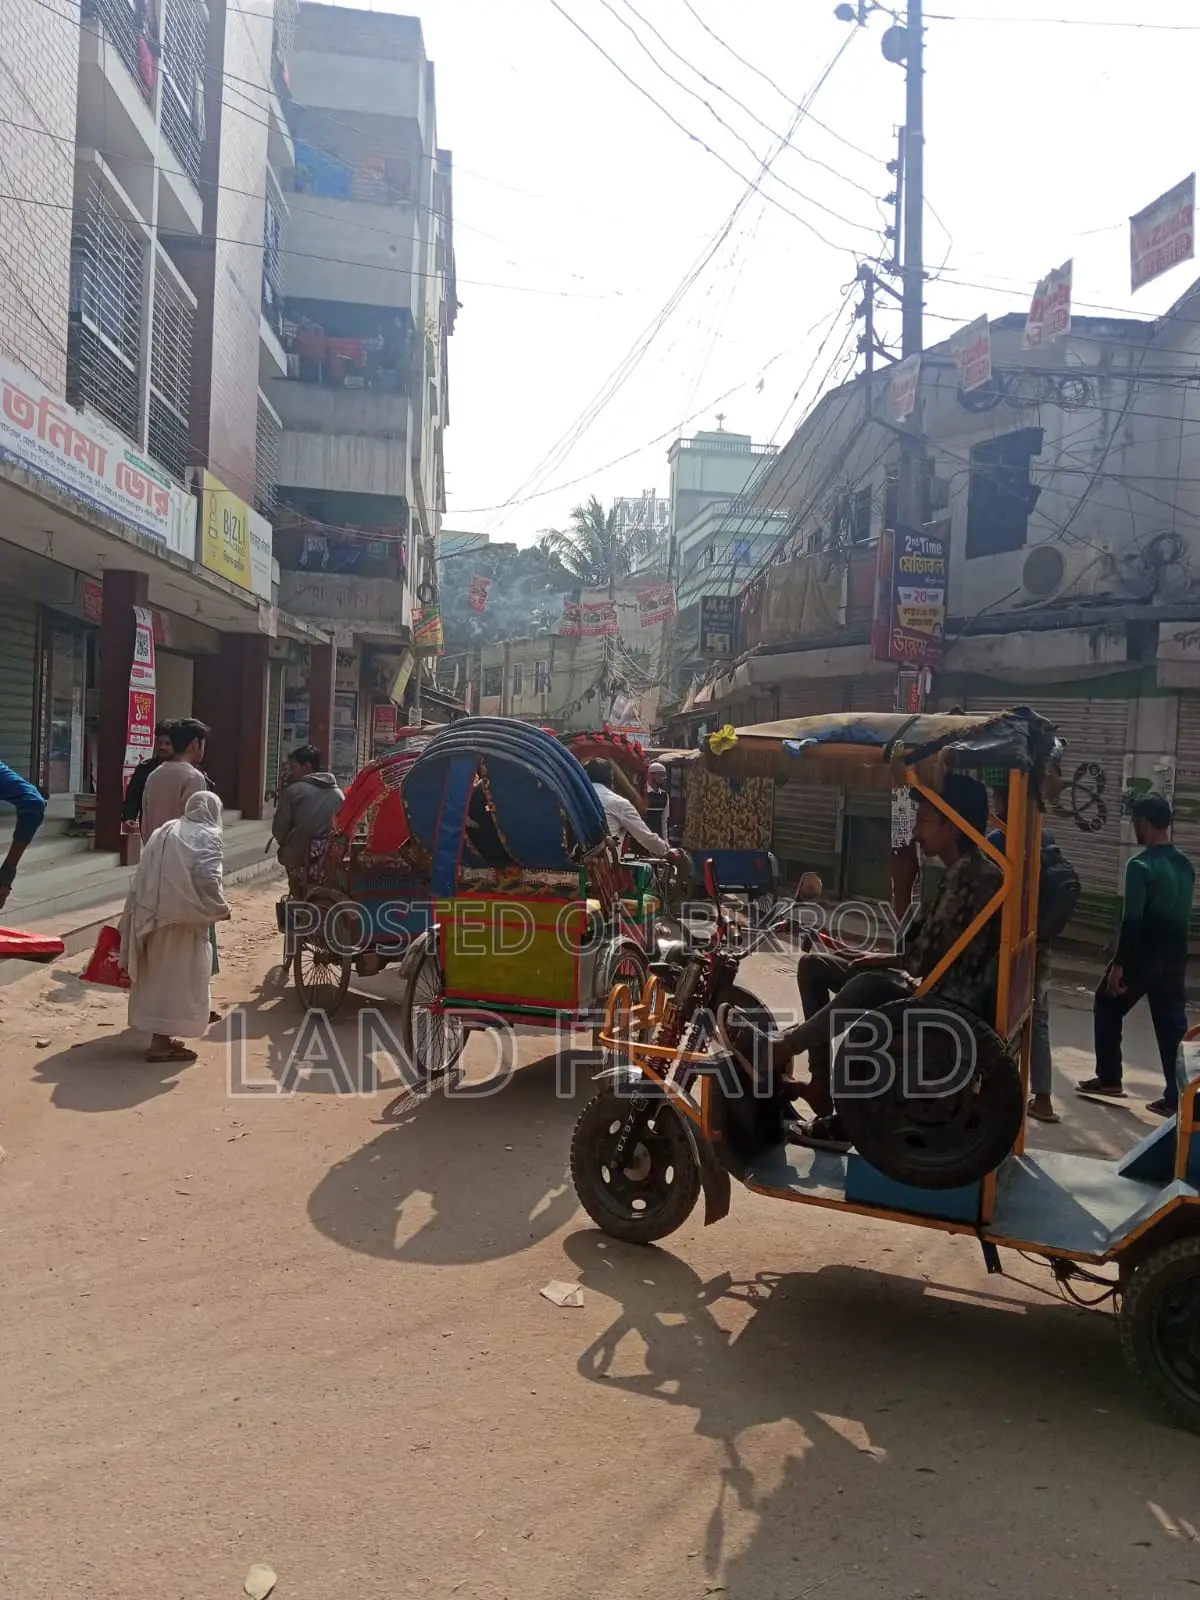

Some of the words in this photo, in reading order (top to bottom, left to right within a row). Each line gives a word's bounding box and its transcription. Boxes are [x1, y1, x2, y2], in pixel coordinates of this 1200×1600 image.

[1, 377, 108, 478] তনিমা
[116, 460, 169, 516] ডোর
[919, 537, 943, 555] Time
